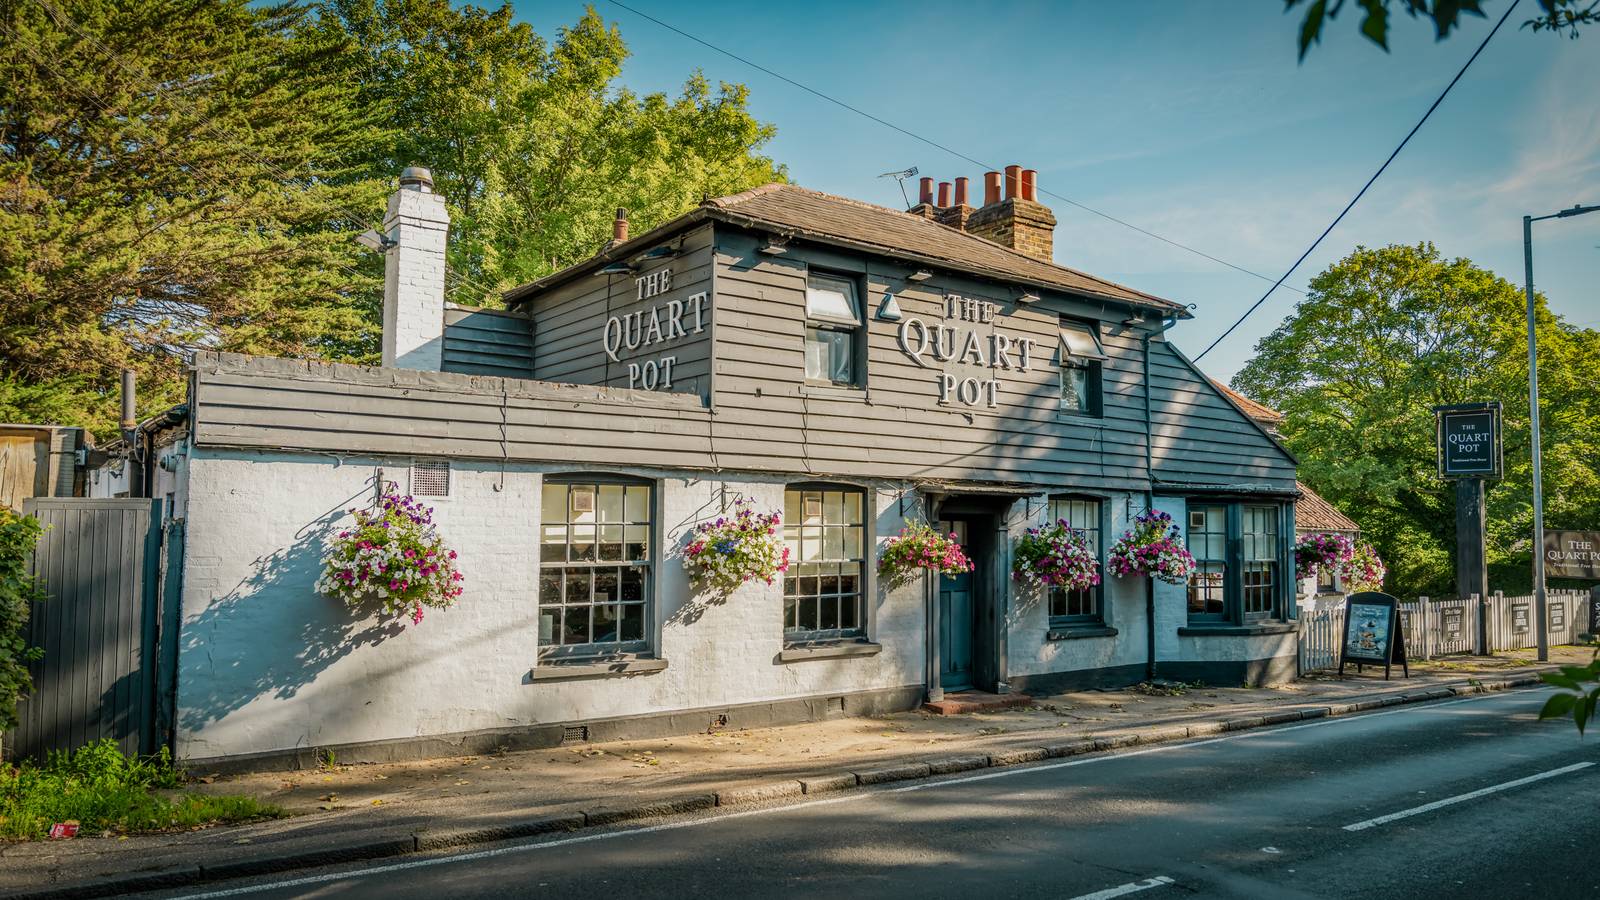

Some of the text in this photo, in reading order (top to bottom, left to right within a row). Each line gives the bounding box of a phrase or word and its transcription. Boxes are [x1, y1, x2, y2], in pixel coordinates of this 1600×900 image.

[635, 268, 670, 301] THE
[945, 293, 995, 322] THE
[603, 291, 707, 362] QUART
[900, 318, 1037, 371] QUART
[628, 356, 676, 391] POT
[940, 373, 1001, 407] POT
[1448, 432, 1490, 445] QUART
[1458, 443, 1480, 453] POT
[1547, 550, 1588, 561] QUART
[1567, 540, 1592, 550] THE
